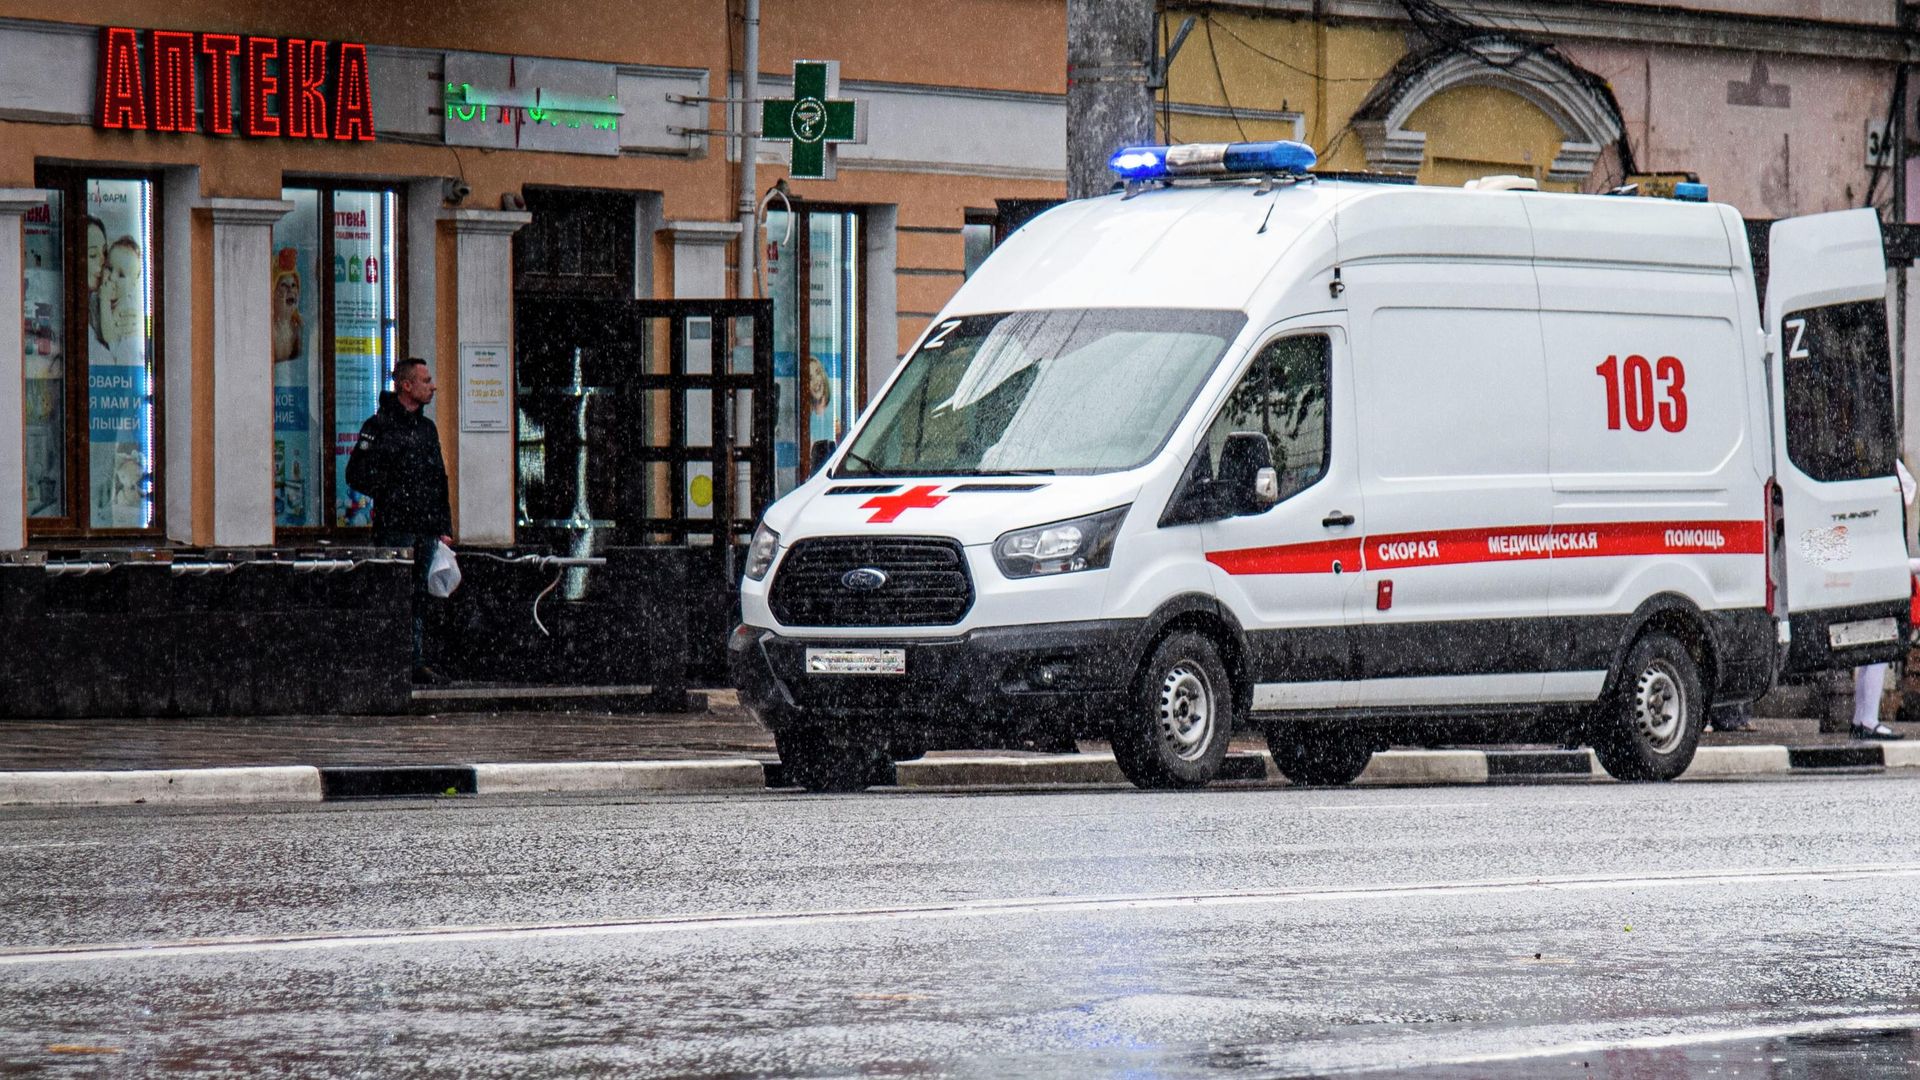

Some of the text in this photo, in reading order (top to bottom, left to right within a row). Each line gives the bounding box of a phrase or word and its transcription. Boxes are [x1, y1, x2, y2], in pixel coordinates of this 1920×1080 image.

[102, 27, 376, 141] АПТЕКА
[924, 320, 962, 349] Z
[1785, 318, 1809, 359] Z
[101, 396, 129, 409] МАМ
[133, 396, 142, 409] И
[1595, 354, 1688, 433] 103
[89, 414, 141, 430] ЛЫШЕЙ
[1831, 510, 1879, 521] TRANSIT
[1377, 529, 1725, 561] СКОРАЯ МЕДИЦИНСКАЯ ПОМОЩЬ
